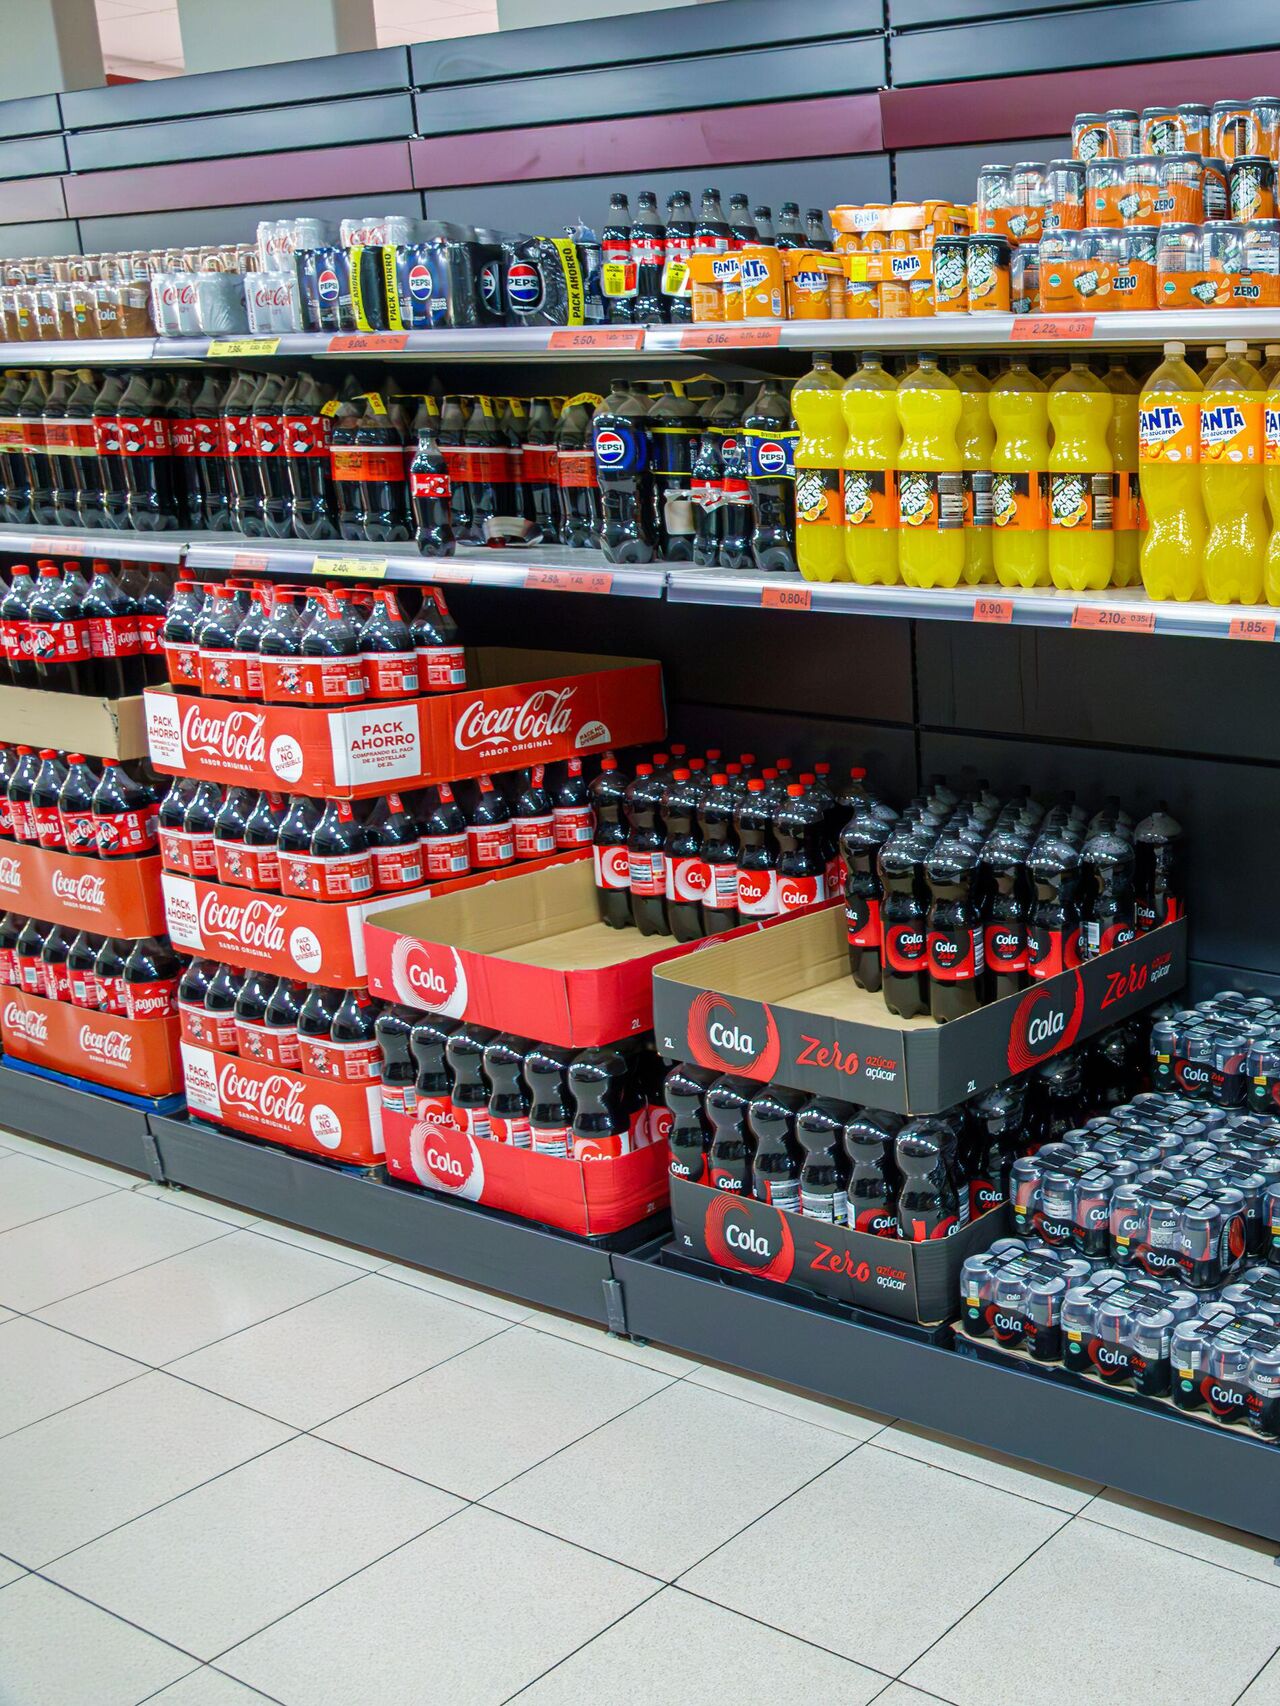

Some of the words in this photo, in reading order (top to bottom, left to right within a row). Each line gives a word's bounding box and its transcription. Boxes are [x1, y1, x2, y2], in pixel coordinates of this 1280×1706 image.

[892, 256, 920, 271] FANTA
[411, 279, 431, 287] PEPSI
[1113, 277, 1137, 290] ZERO
[1234, 286, 1259, 297] ZERO
[1099, 612, 1127, 624] 2,10€
[1240, 621, 1267, 633] 1,85€
[153, 715, 173, 727] PACK
[455, 687, 578, 751] Coca-Cola
[150, 726, 180, 741] AHORRO
[183, 705, 266, 762] Coca-Cola
[361, 721, 403, 737] PACK
[351, 733, 415, 752] AHORRO
[479, 747, 509, 758] SABOR
[512, 739, 553, 753] ORIGINAL
[280, 751, 293, 762] NO
[52, 869, 105, 907] Coca-Cola
[739, 885, 762, 897] Cola
[171, 895, 191, 910] PACK
[783, 892, 808, 904] Cola
[201, 890, 287, 952] Coca-Cola
[901, 934, 924, 944] Cola
[935, 942, 958, 952] Cola
[409, 965, 448, 993] Cola
[1101, 963, 1147, 1009] Zero
[1029, 1011, 1064, 1044] Cola
[664, 1037, 674, 1049] 2L
[710, 1023, 755, 1054] Cola
[796, 1034, 859, 1075] Zero
[866, 1067, 897, 1082] açúcar
[1183, 1066, 1210, 1082] Cola
[219, 1063, 306, 1125] Coca-Cola
[427, 1148, 464, 1177] Cola
[684, 1235, 693, 1246] 2L
[726, 1224, 770, 1257] Cola
[811, 1241, 871, 1283] Zero
[877, 1274, 907, 1291] açúcar
[1212, 1386, 1244, 1406] Cola
